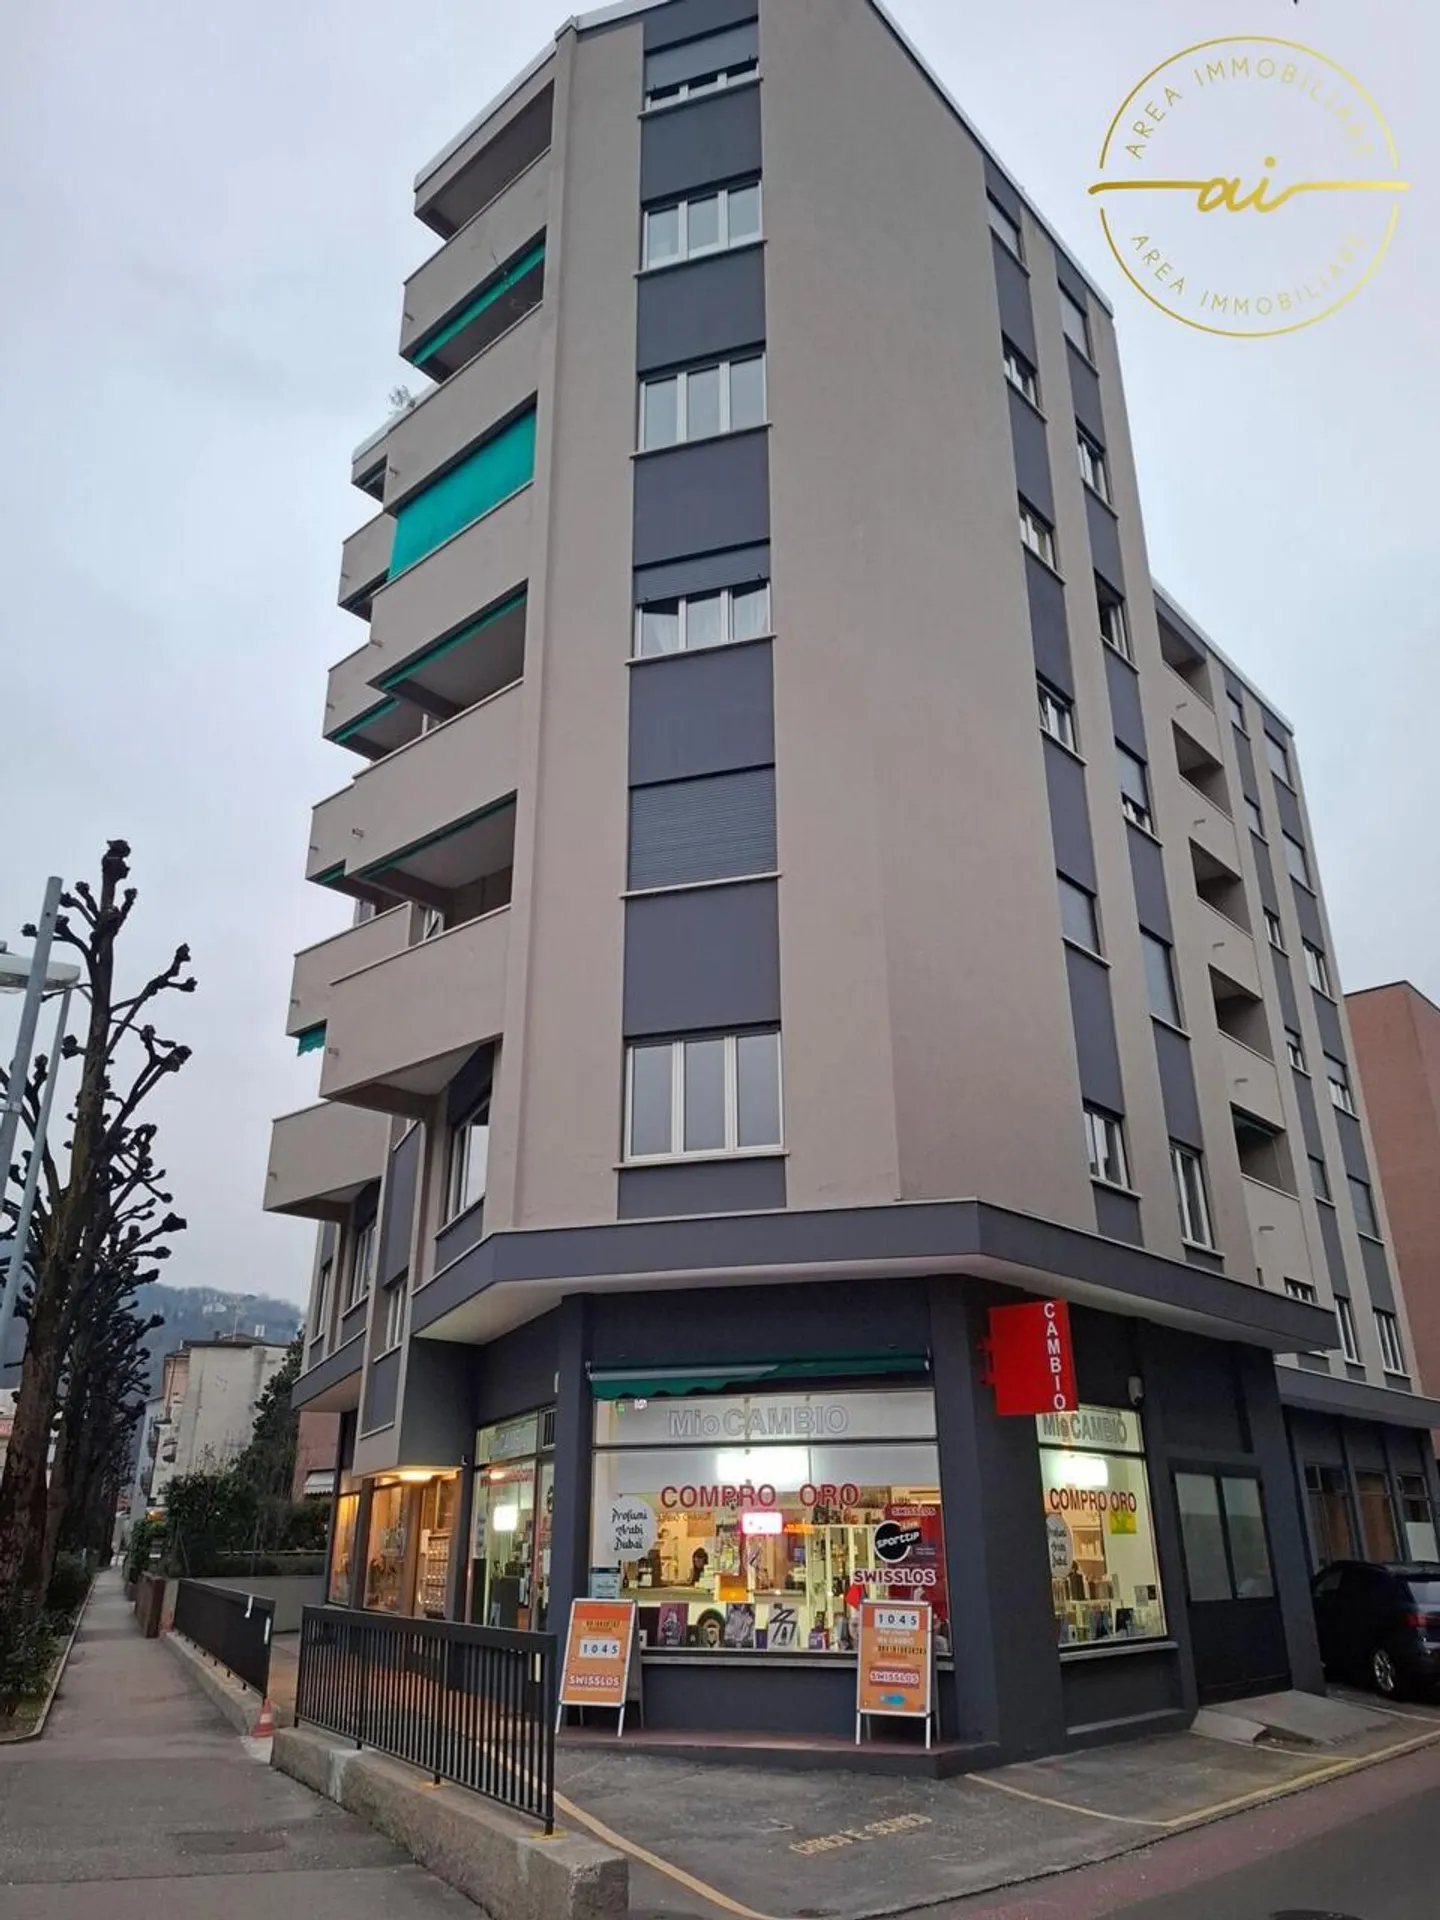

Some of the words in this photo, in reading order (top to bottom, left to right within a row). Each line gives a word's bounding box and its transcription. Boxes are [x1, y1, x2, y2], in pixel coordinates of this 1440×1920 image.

[1044, 1302, 1067, 1411] CAMBIO
[660, 1483, 777, 1509] COMPRO
[799, 1482, 861, 1507] ORO
[1050, 1487, 1107, 1511] COMPRO
[1110, 1490, 1137, 1512] ORO
[854, 1568, 936, 1585] SWISSLOS
[878, 1614, 918, 1625] 1045
[583, 1644, 619, 1655] 1045
[568, 1674, 620, 1688] SWISSLOS
[870, 1670, 919, 1685] SWISSLOS
